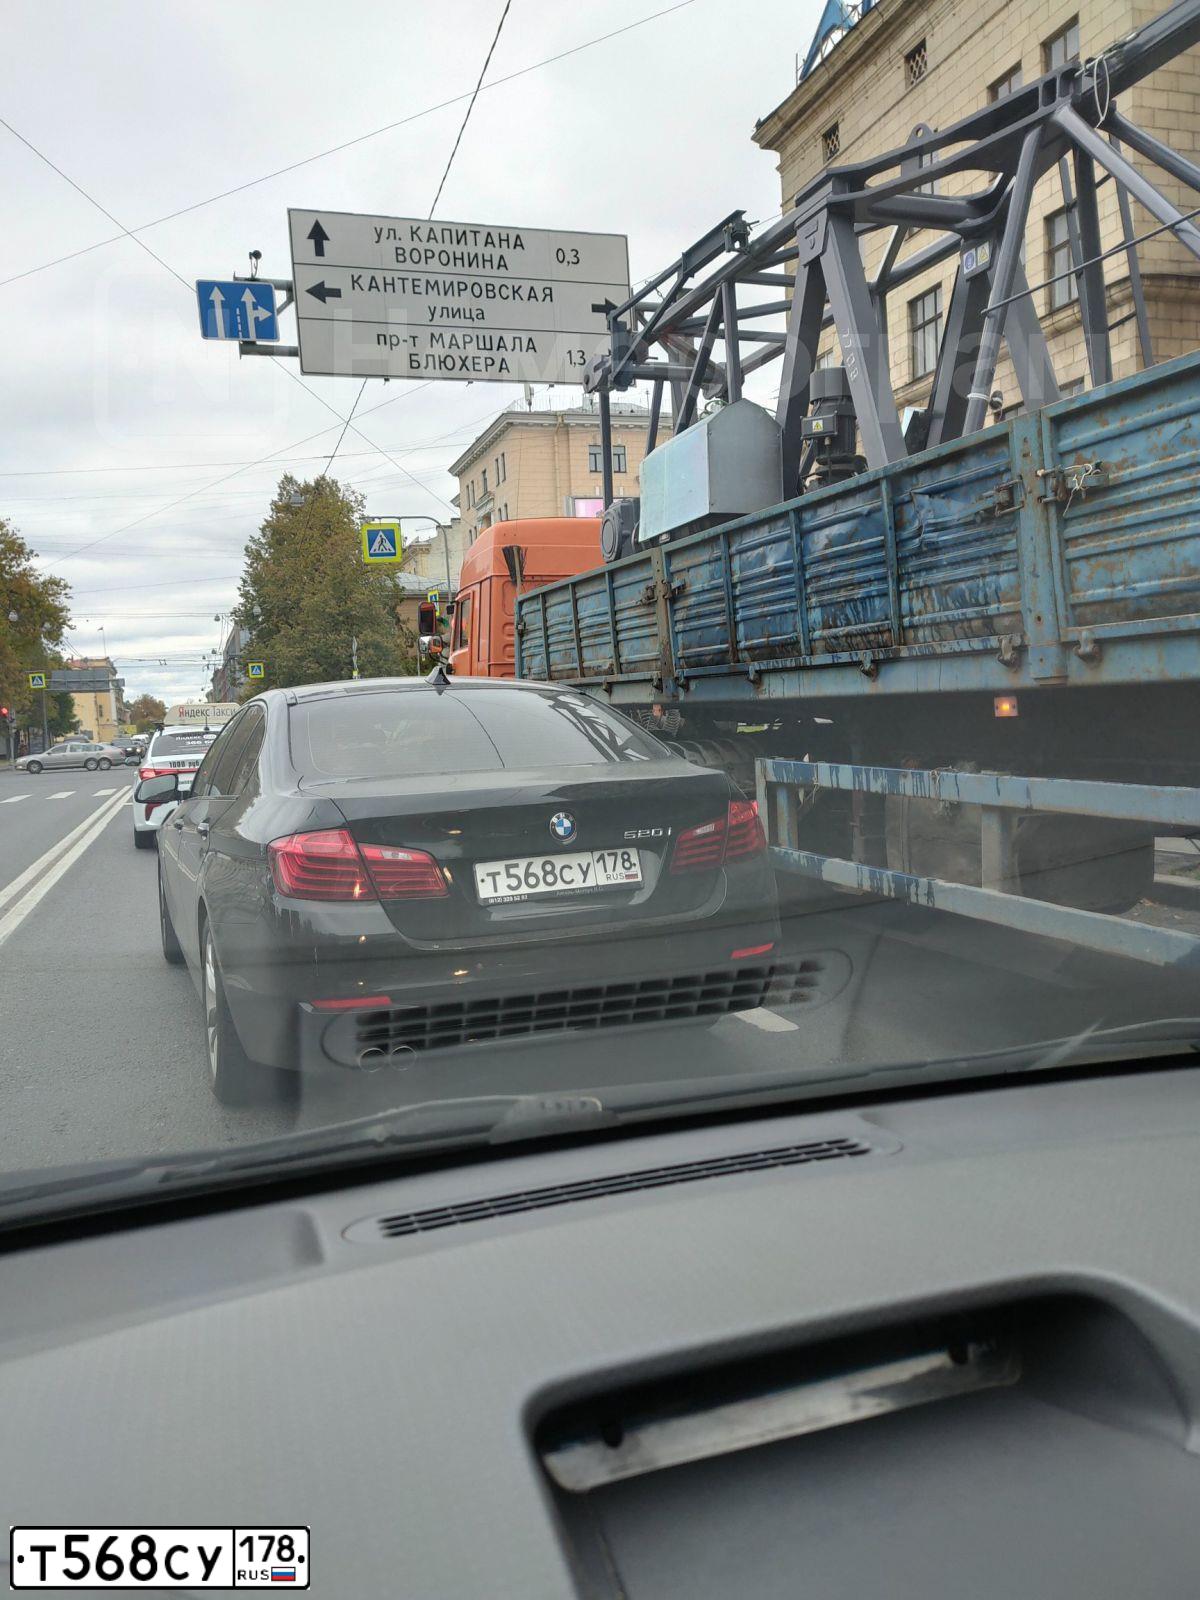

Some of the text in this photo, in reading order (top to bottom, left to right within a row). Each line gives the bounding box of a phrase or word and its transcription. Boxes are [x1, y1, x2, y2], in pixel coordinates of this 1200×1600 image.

[374, 225, 525, 250] ул. КАПИТАНА
[395, 247, 509, 271] ВОРОНИНА
[556, 247, 581, 266] 0,3
[350, 274, 554, 303] КАНТЕМИРОВСКАЯ
[428, 305, 485, 322] улица
[376, 332, 537, 353] пр-т МАРШАЛА
[409, 353, 510, 373] БЛЮХЕРА
[566, 350, 586, 367] 1,3
[179, 706, 210, 718] Яндекс
[595, 850, 633, 874] 178
[605, 873, 625, 881] RUS
